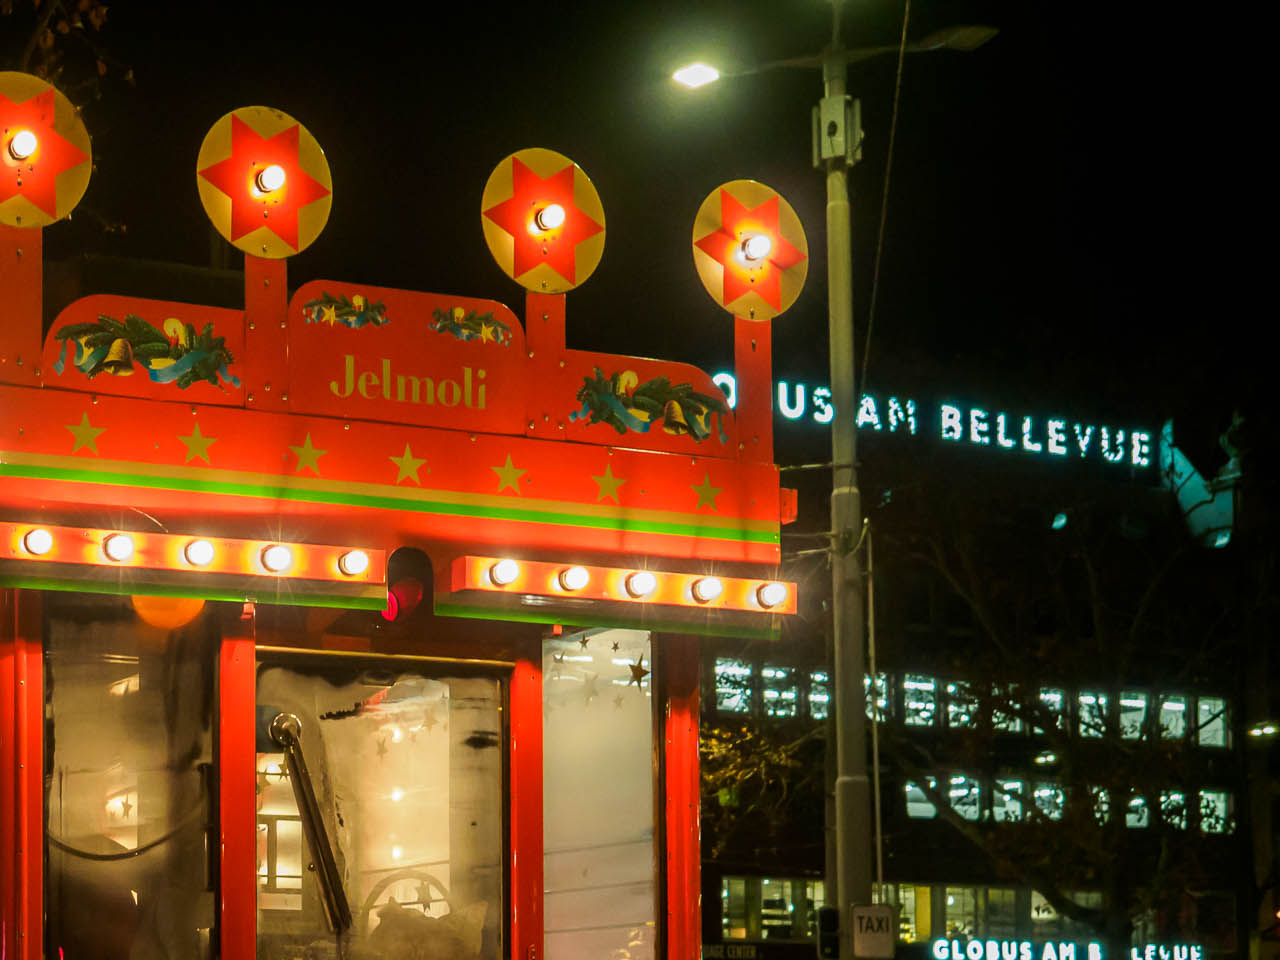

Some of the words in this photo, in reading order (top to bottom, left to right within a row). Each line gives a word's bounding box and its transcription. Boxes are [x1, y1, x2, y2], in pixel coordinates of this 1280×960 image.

[330, 355, 487, 409] Jelmoli
[856, 394, 916, 435] AM
[941, 404, 1150, 466] BELLEVUE
[858, 916, 889, 933] TAXI
